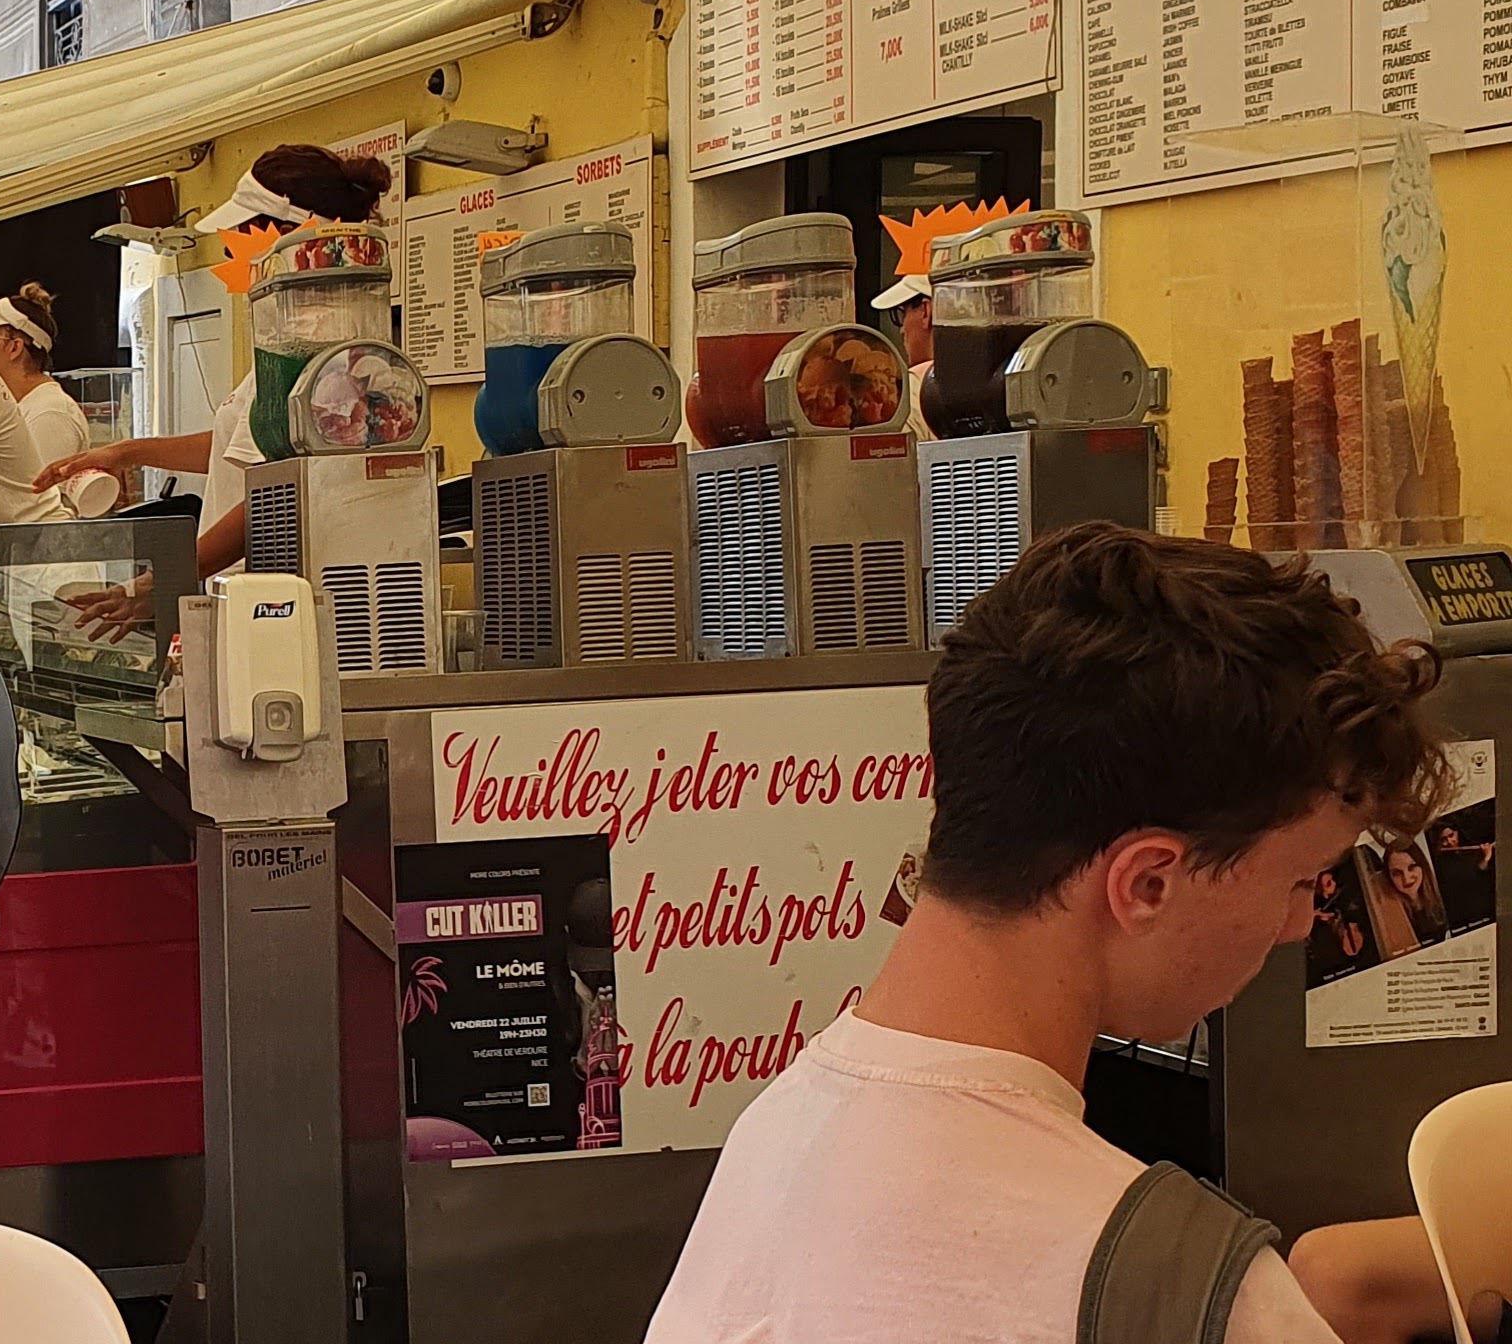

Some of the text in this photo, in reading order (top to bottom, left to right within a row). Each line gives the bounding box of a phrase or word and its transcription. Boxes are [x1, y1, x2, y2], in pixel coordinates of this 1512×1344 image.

[1383, 25, 1407, 41] FIGUE
[880, 36, 903, 64] 7,00€
[1383, 40, 1412, 56] FRAISE
[1383, 50, 1431, 70] FRAMBOISE
[1383, 69, 1416, 85] GOYAVE
[1483, 71, 1508, 86] THYM
[1383, 83, 1418, 99] GRIOTTE
[576, 154, 622, 185] SORBETS
[459, 189, 494, 214] GLACES
[1431, 562, 1493, 590] GLACES
[256, 603, 293, 617] Purell
[443, 727, 635, 849] Veuillez
[625, 731, 760, 844] jeter
[767, 752, 841, 807] vos
[232, 847, 304, 868] BOBET
[426, 901, 538, 937] CUT KILLER
[612, 860, 866, 974] et petits pots
[476, 959, 545, 979] LE MÔME
[450, 1016, 547, 1030] VENDREDI 22 JUILLET
[499, 1028, 547, 1040] 19H-23H30
[645, 997, 692, 1088] la
[504, 1048, 512, 1056] DE
[514, 1045, 548, 1056] VERDURE
[531, 1059, 549, 1067] NICE
